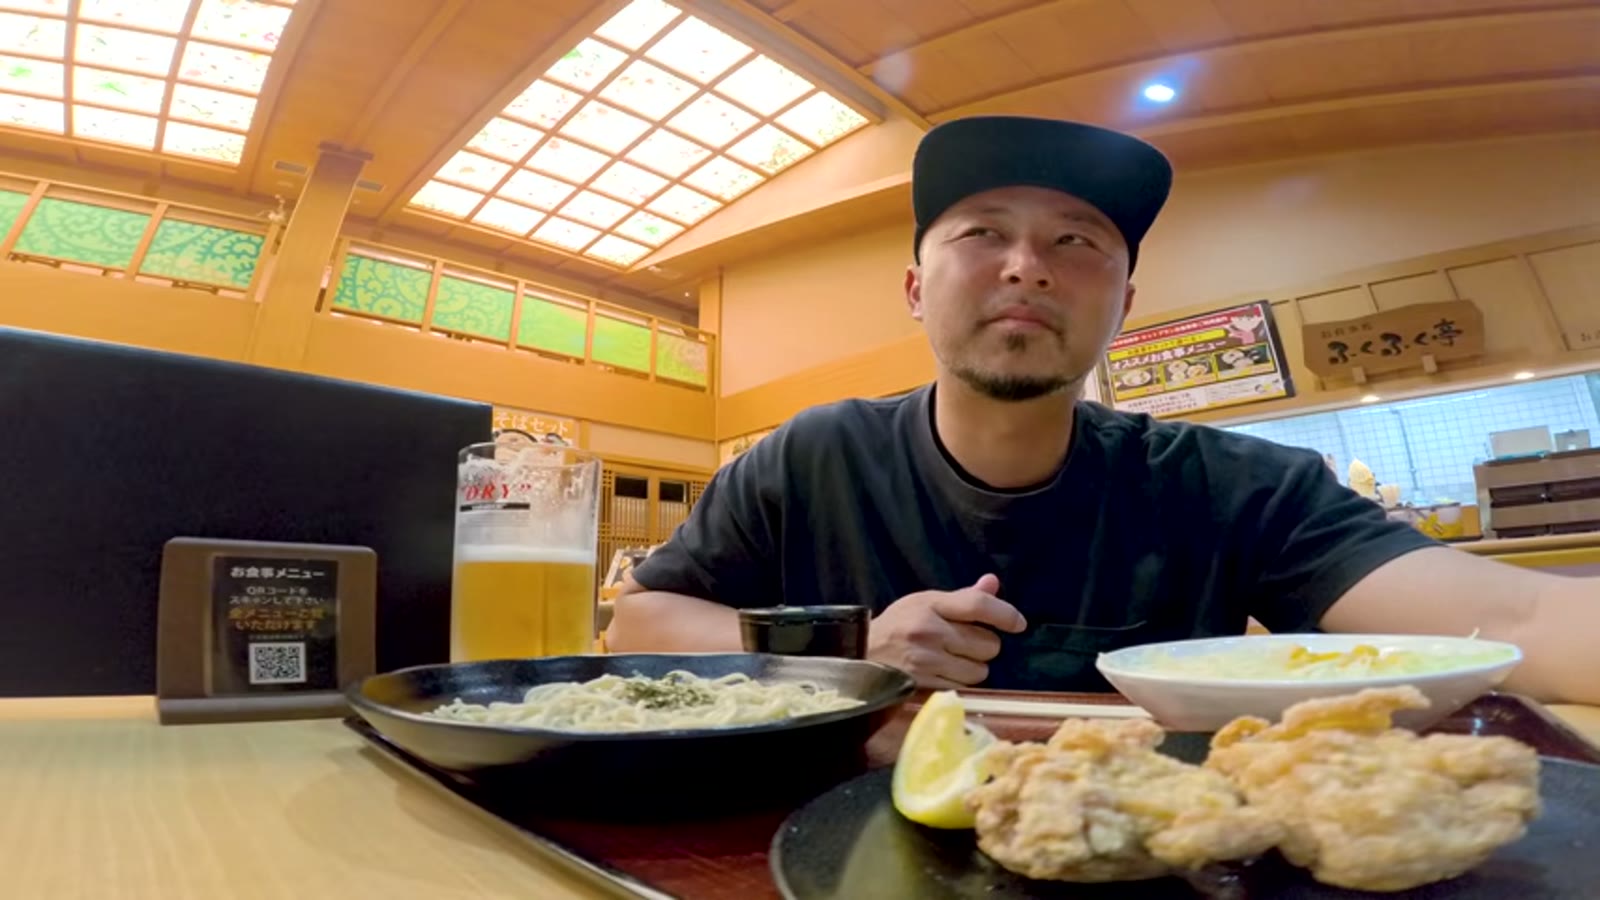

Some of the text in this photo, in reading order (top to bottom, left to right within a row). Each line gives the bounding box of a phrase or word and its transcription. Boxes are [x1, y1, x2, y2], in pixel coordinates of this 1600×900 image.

[1327, 317, 1463, 365] ふくふく亭
[495, 411, 569, 435] そばセット
[230, 566, 325, 579] お食事メニュー
